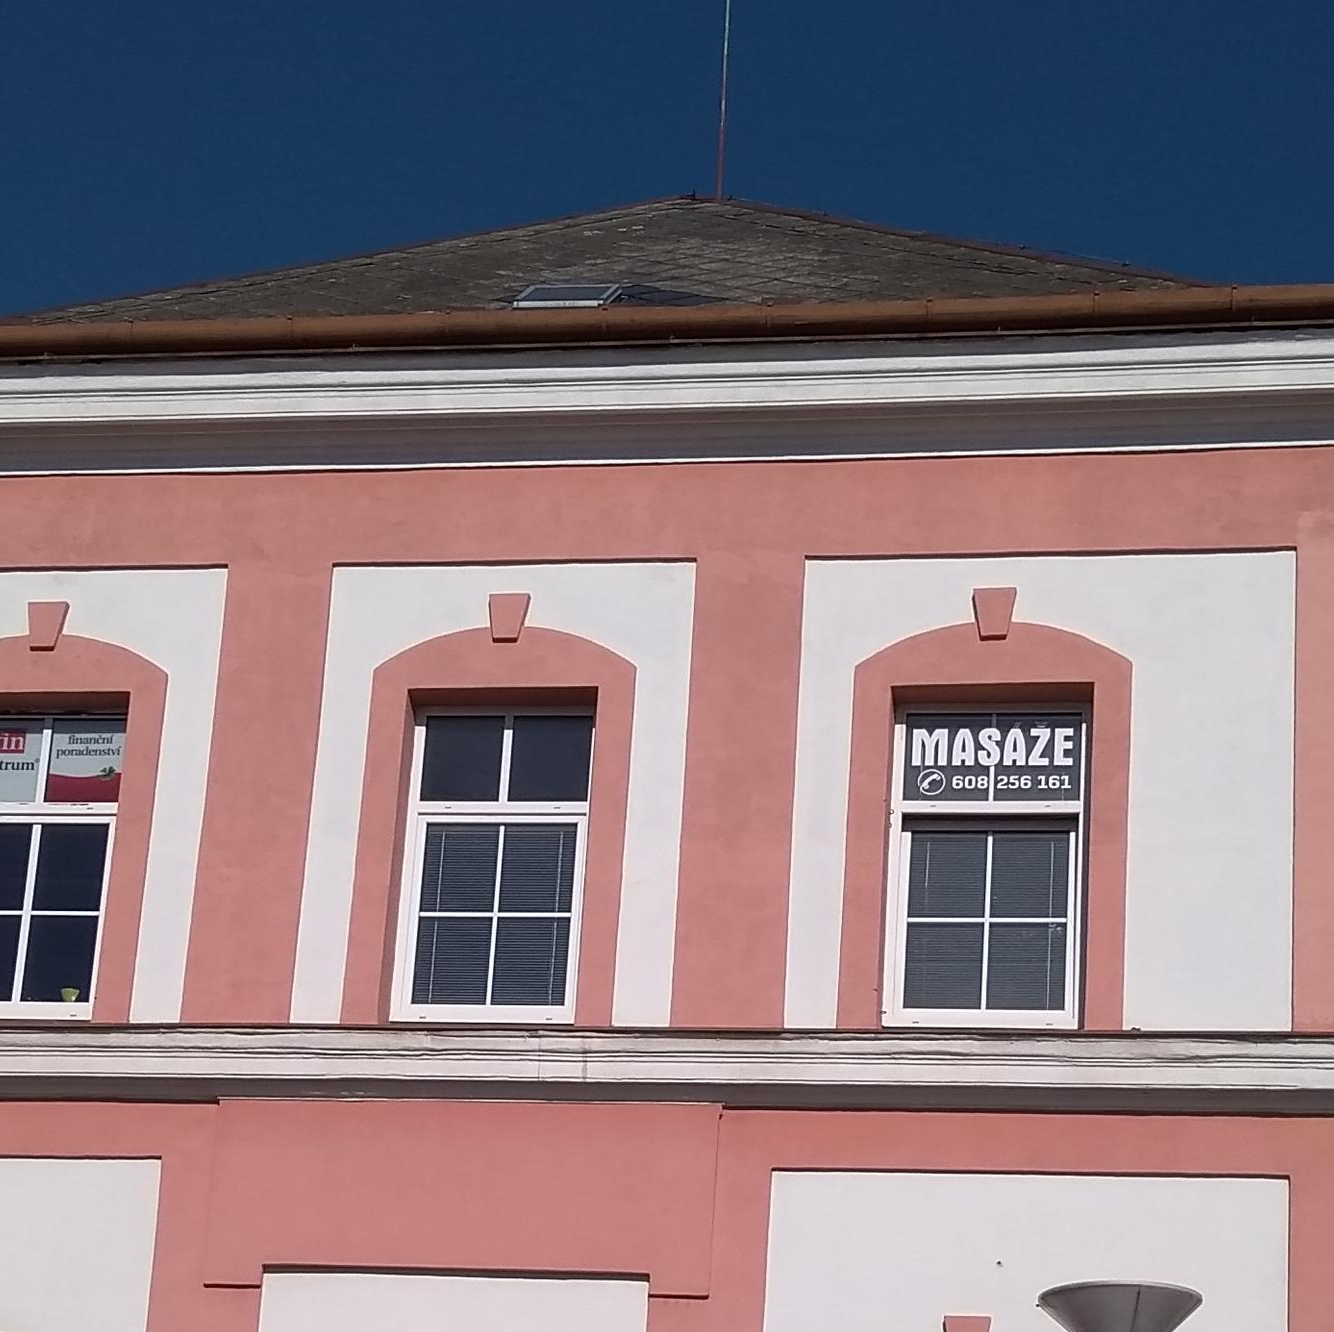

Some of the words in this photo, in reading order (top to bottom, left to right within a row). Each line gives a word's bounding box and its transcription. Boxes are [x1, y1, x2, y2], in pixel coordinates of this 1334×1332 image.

[68, 735, 114, 745] finanční
[911, 721, 1074, 766] MASÁŽE
[56, 746, 122, 759] poradenství
[952, 775, 988, 789] 608
[997, 775, 1032, 789] 256
[1037, 775, 1071, 789] 161
